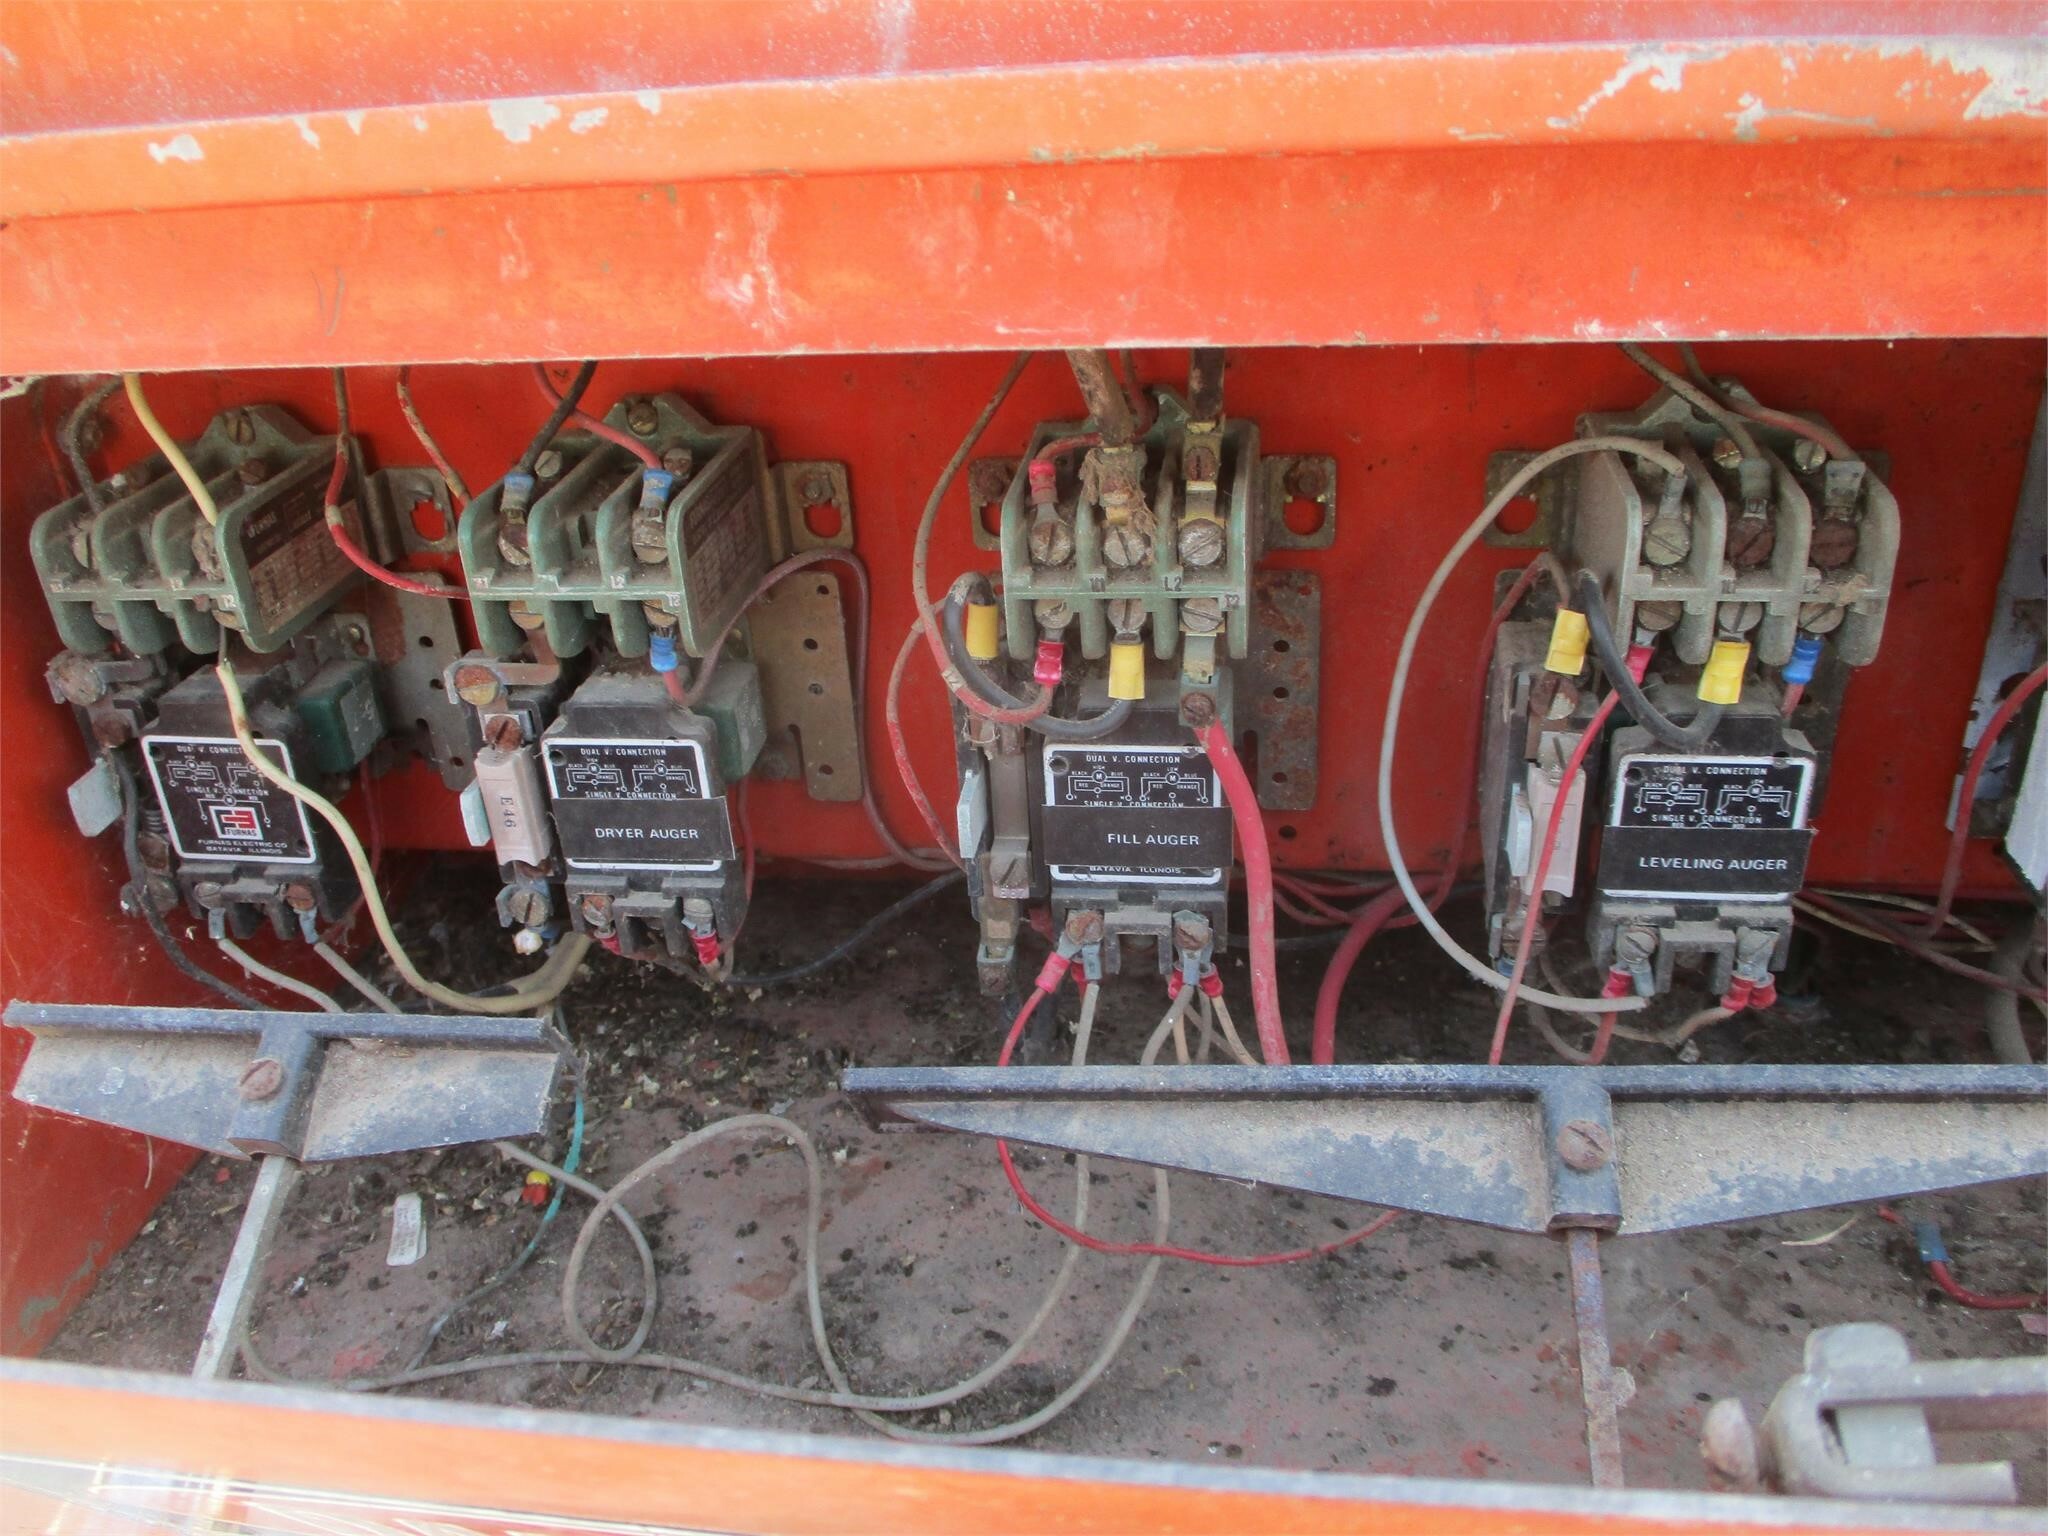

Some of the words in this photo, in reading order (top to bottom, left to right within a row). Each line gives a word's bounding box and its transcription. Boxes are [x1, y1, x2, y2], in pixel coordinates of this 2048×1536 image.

[1164, 576, 1182, 592] L2
[580, 748, 600, 756] DUAL
[616, 748, 667, 756] CONNECTION
[1086, 754, 1108, 762] DUAL
[1124, 756, 1180, 764] CONNECTION
[1706, 766, 1768, 775] CONNECTION
[500, 798, 516, 828] E46
[1652, 814, 1685, 822] SINGLE
[1703, 815, 1762, 824] CONNECTION
[594, 828, 644, 838] DRYER
[650, 828, 699, 839] AUGER
[1108, 834, 1141, 844] FILL
[1146, 835, 1200, 845] AUGER
[1639, 857, 1724, 870] LEVELING
[1728, 859, 1788, 870] AUGER
